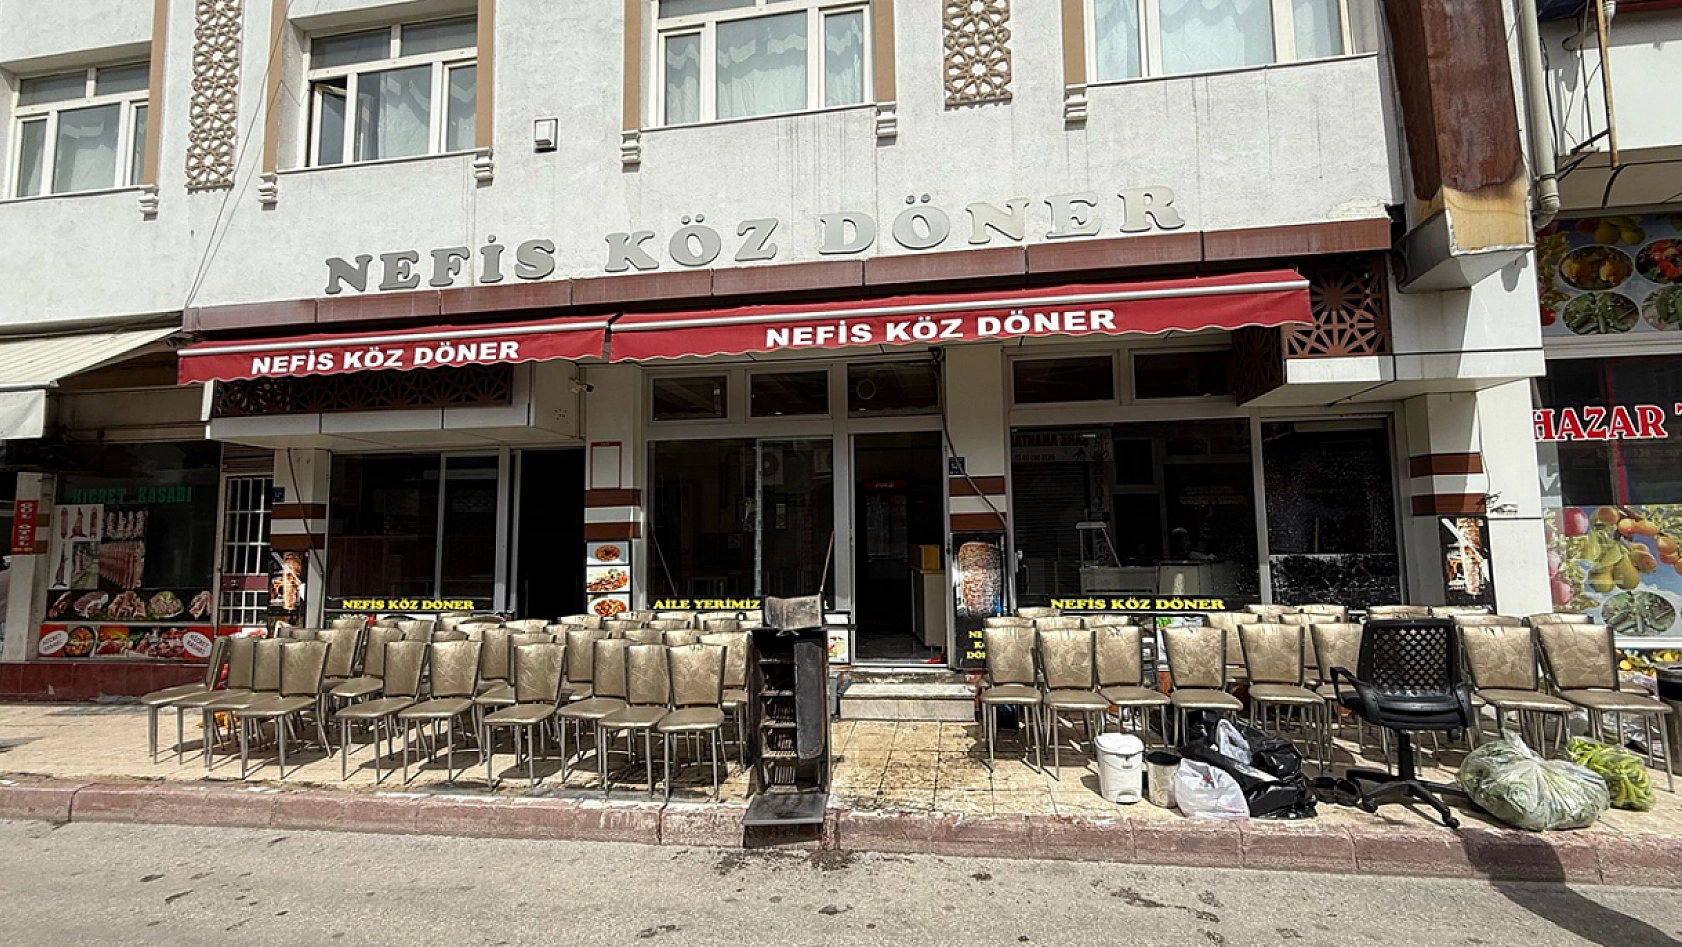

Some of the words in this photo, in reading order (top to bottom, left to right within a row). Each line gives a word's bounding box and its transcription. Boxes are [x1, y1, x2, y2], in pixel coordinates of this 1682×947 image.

[325, 235, 555, 295] NEFİS
[605, 214, 779, 273] KÖZ
[819, 187, 1186, 256] DÖNER
[765, 319, 872, 348] NEFİS
[886, 314, 965, 342] KÖZ
[978, 308, 1117, 334] DÖNER
[251, 347, 334, 375] NEFİS
[344, 345, 403, 369] KÖZ
[414, 340, 519, 365] DÖNER
[1532, 404, 1668, 441] HAZAR
[342, 598, 385, 610] NEFİS
[388, 598, 418, 610] KÖZ
[423, 599, 474, 610] DÖNER
[653, 599, 690, 609] AİLE
[694, 598, 760, 609] YERİMİZ
[1050, 597, 1106, 610] NEFİS
[1111, 597, 1151, 610] KÖZ
[1155, 597, 1226, 610] DÖNER
